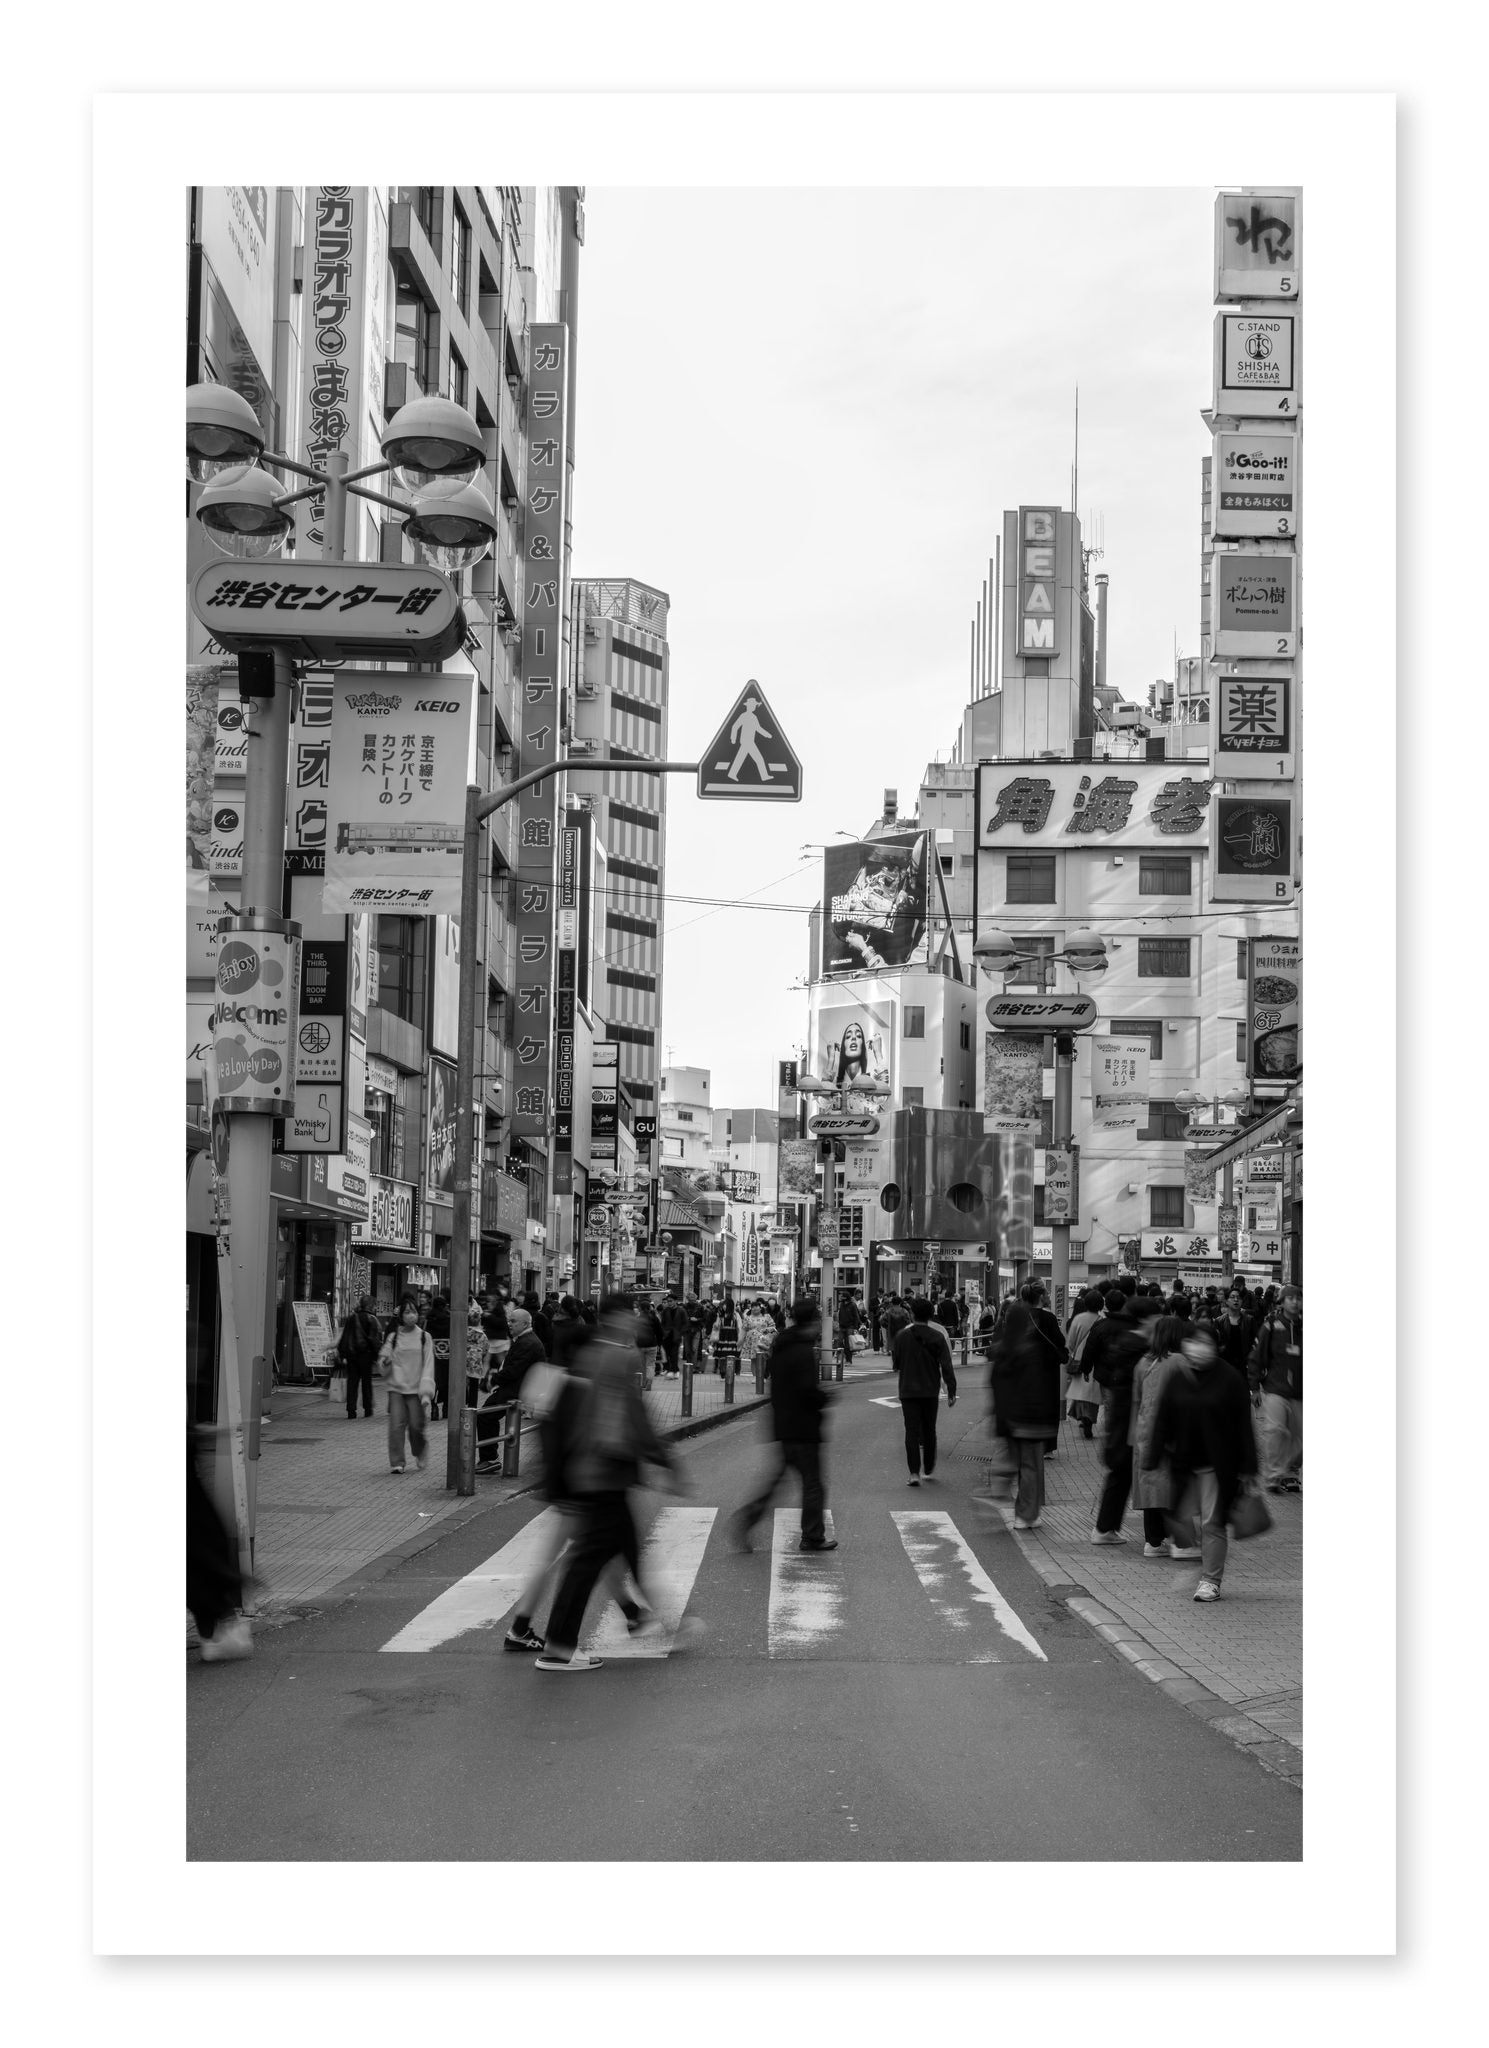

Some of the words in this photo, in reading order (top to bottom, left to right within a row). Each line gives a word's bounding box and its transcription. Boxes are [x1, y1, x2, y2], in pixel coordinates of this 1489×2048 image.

[1226, 206, 1292, 264] わん
[314, 198, 350, 326] カラオケ
[1280, 278, 1291, 292] 5
[1238, 323, 1281, 332] C.STAND
[1238, 361, 1280, 371] SHISHA
[306, 358, 350, 546] まねき
[1236, 454, 1288, 468] Goo-it!
[1229, 472, 1285, 481] 渋谷宇田川町店
[1225, 496, 1289, 508] 全身もみほぐし
[1277, 518, 1289, 533] 3
[1024, 511, 1055, 647] BEAM
[206, 580, 442, 615] 渋谷センター街
[1225, 586, 1287, 604] ポムの樹
[1277, 639, 1288, 653] 2
[357, 707, 391, 715] KANTO
[414, 700, 460, 713] KEIO
[1229, 685, 1277, 733] 薬
[1223, 736, 1282, 749] マツモトキヨシ
[362, 734, 377, 774] 冒険へ
[219, 761, 241, 769] 渋谷店
[379, 734, 396, 804] カントーの
[399, 734, 416, 805] ポケパーク
[419, 735, 435, 791] 京王線で
[1276, 760, 1285, 774] 1
[986, 777, 1212, 835] 角海老
[1223, 813, 1281, 859] 一蘭
[562, 833, 574, 866] kimono
[215, 862, 238, 870] 渋谷店
[350, 888, 433, 901] 渋谷センター街
[1275, 882, 1287, 897] B
[217, 954, 258, 986] Enjoy
[215, 1001, 288, 1026] Welcome
[993, 1002, 1090, 1016] 渋谷センター街
[1254, 1012, 1282, 1030] 6F
[231, 1057, 259, 1074] Lovely
[261, 1057, 281, 1070] Day!
[295, 1119, 326, 1130] Whisky
[636, 1122, 656, 1133] GU
[812, 1120, 871, 1129] 渋谷センター街
[294, 1128, 313, 1137] Bank
[1187, 1129, 1241, 1137] 渋谷センター街
[1154, 1236, 1210, 1256] 兆楽
[748, 1234, 757, 1274] BEER
